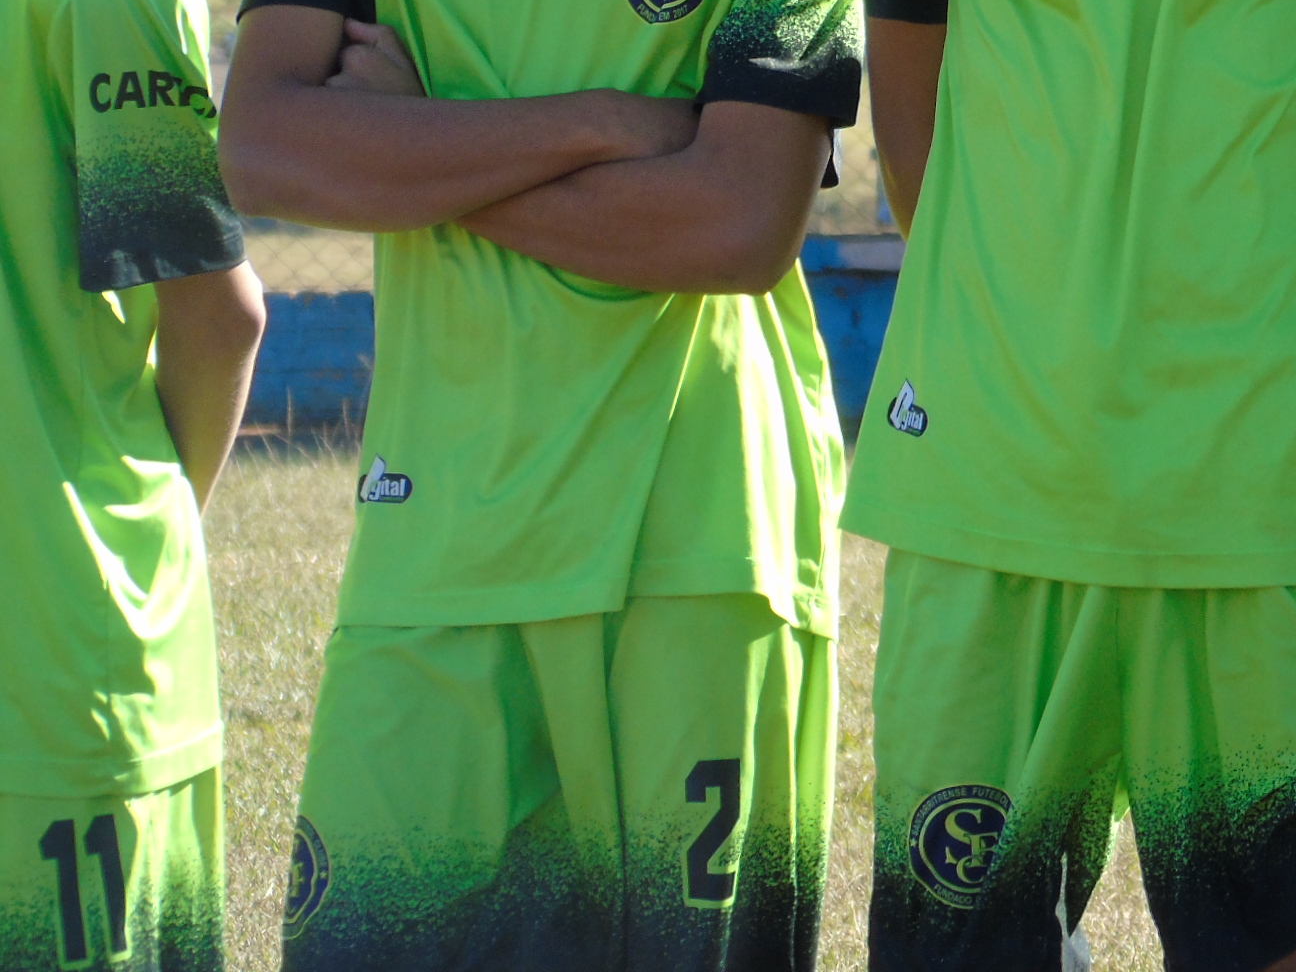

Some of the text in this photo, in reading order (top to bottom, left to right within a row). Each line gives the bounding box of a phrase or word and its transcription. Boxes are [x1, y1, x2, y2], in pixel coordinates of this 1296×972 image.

[658, 12, 671, 21] EM
[673, 5, 688, 19] 2017
[972, 788, 1010, 807] FUTEBOL
[684, 757, 741, 902] 2
[38, 813, 132, 965] 11
[934, 884, 972, 904] FUNDADO
